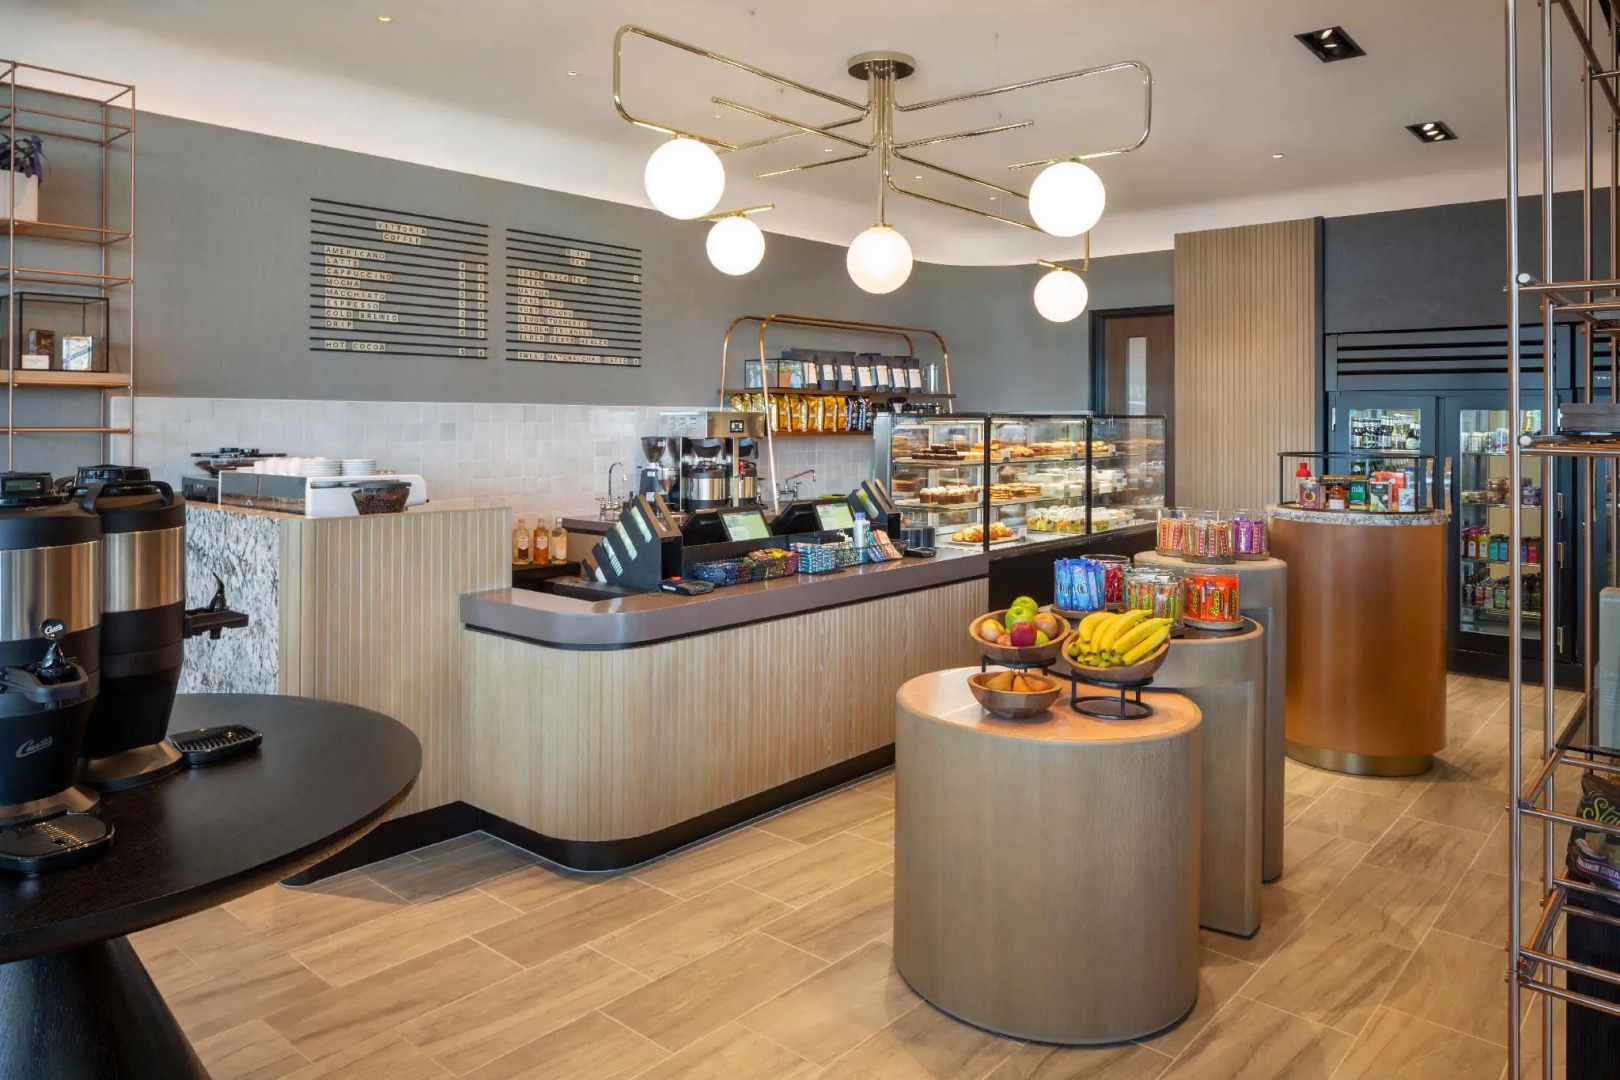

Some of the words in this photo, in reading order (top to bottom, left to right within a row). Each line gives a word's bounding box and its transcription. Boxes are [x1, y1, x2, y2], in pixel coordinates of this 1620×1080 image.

[377, 222, 426, 234] VITTORIA
[383, 233, 420, 243] COFFEE
[326, 247, 385, 260] AMERICANO
[326, 258, 358, 266] LATTE
[326, 268, 392, 280] CAPPUCCINO
[544, 273, 568, 282] BLACK
[326, 279, 359, 287] MOCHA
[519, 279, 544, 287] GREEN
[326, 290, 386, 300] MACCHIATO
[519, 288, 549, 296] MATCHA
[326, 300, 379, 309] ESPRESSO
[360, 312, 398, 322] BREWED
[543, 309, 574, 317] OOLONG
[548, 318, 587, 327] TURMERIC
[554, 328, 592, 336] TRIANGLE
[580, 338, 608, 346] HEALER
[1600, 866, 1620, 880] SUGA
